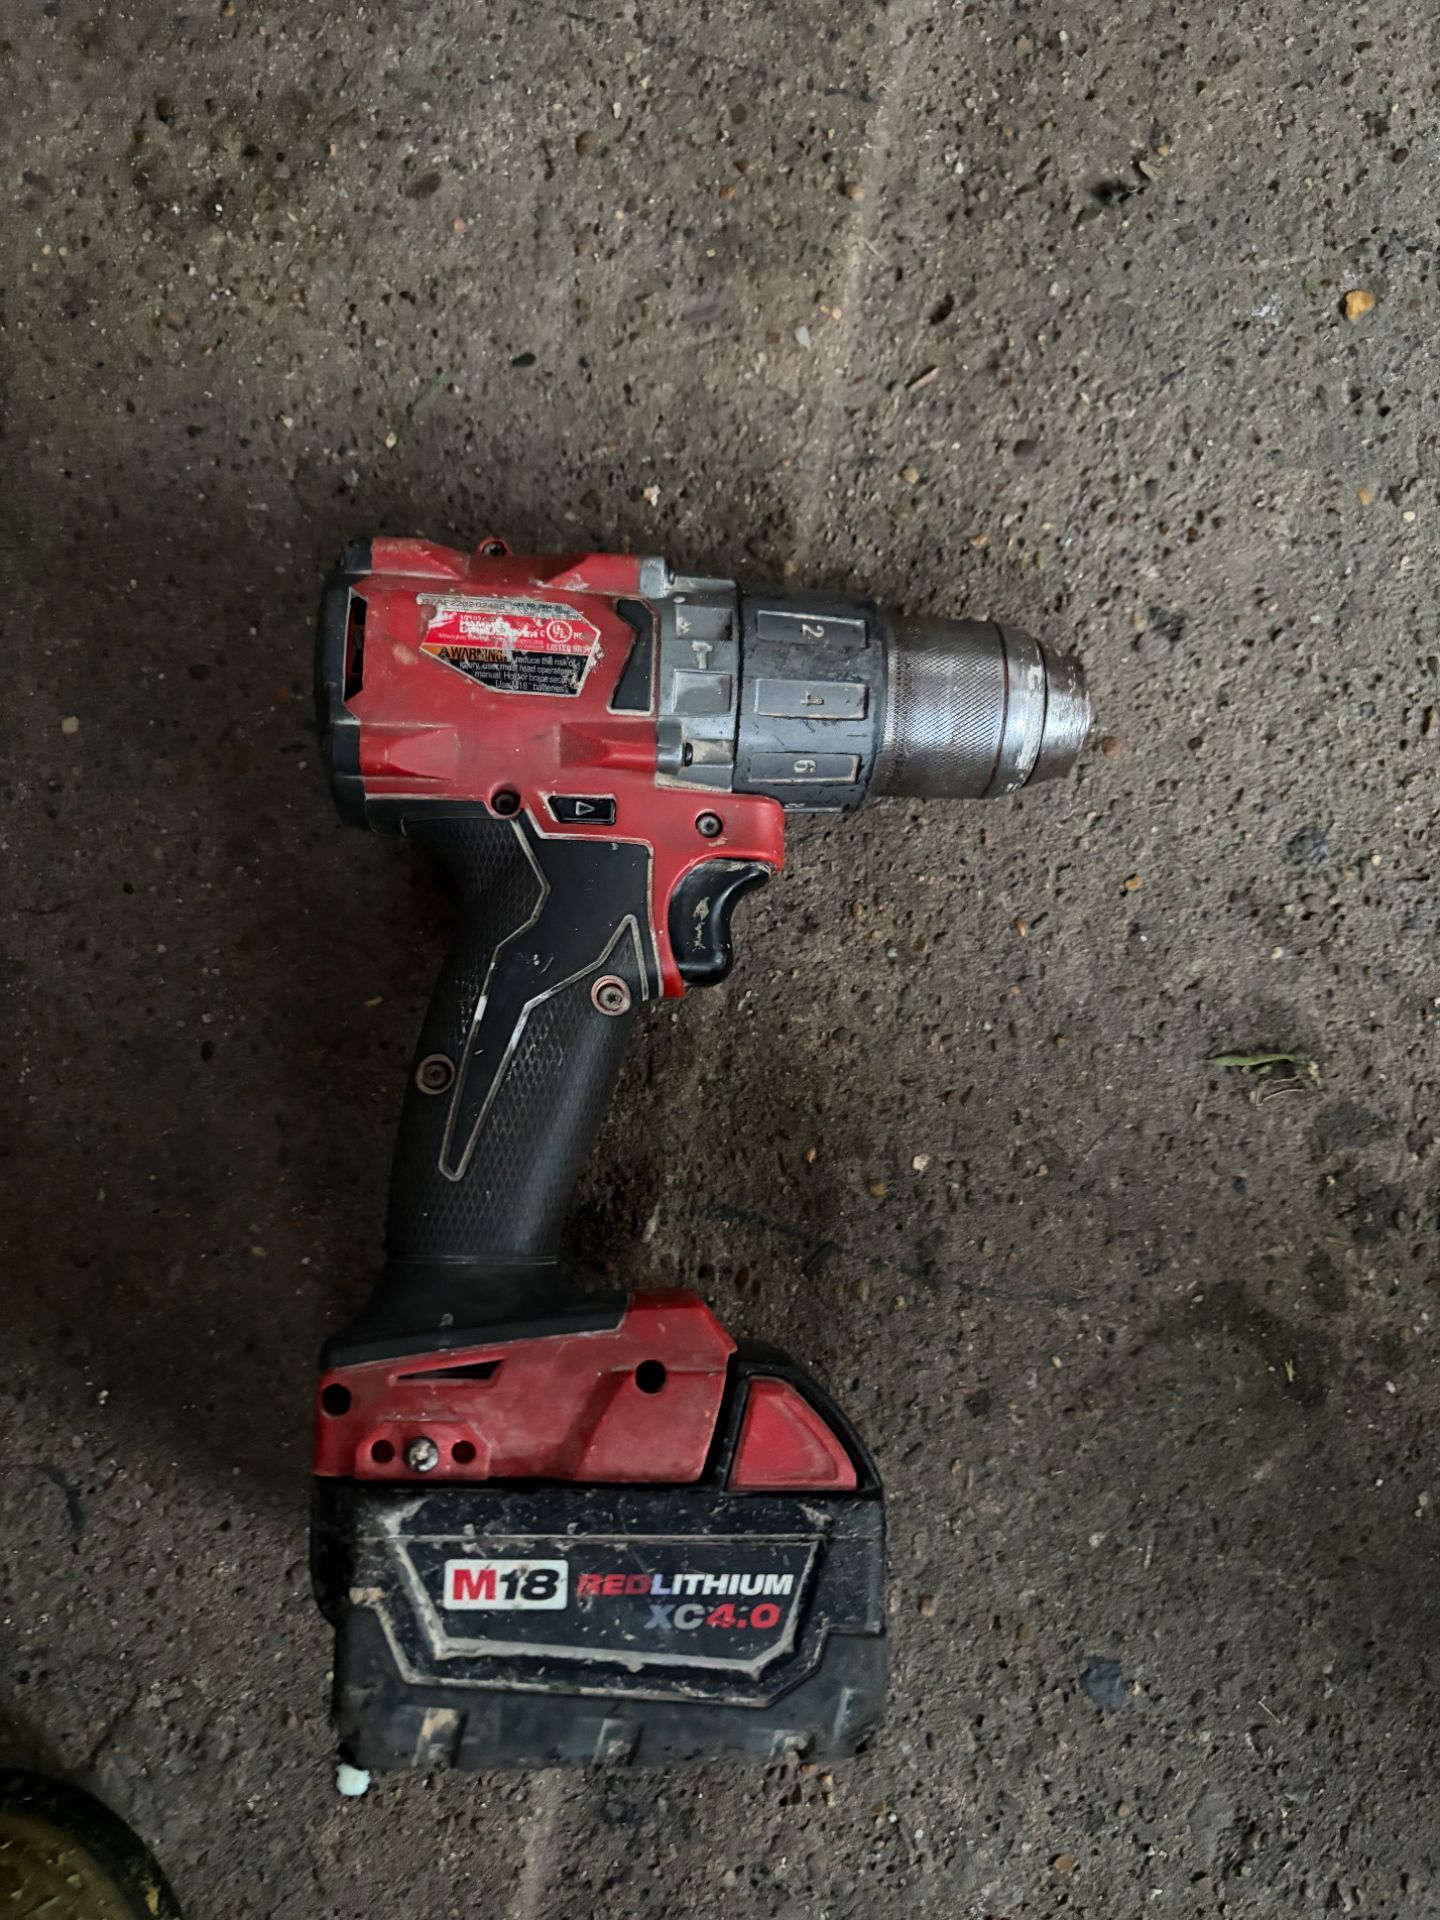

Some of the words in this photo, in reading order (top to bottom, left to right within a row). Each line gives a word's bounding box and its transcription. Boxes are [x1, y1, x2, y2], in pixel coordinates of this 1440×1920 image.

[552, 624, 568, 639] UL
[802, 624, 825, 638] 2
[515, 656, 541, 665] reduce
[800, 690, 824, 706] 4
[793, 759, 817, 773] 6
[452, 1568, 560, 1601] M18
[576, 1573, 793, 1599] REDLITHIUM
[645, 1602, 781, 1630] XC4.0
